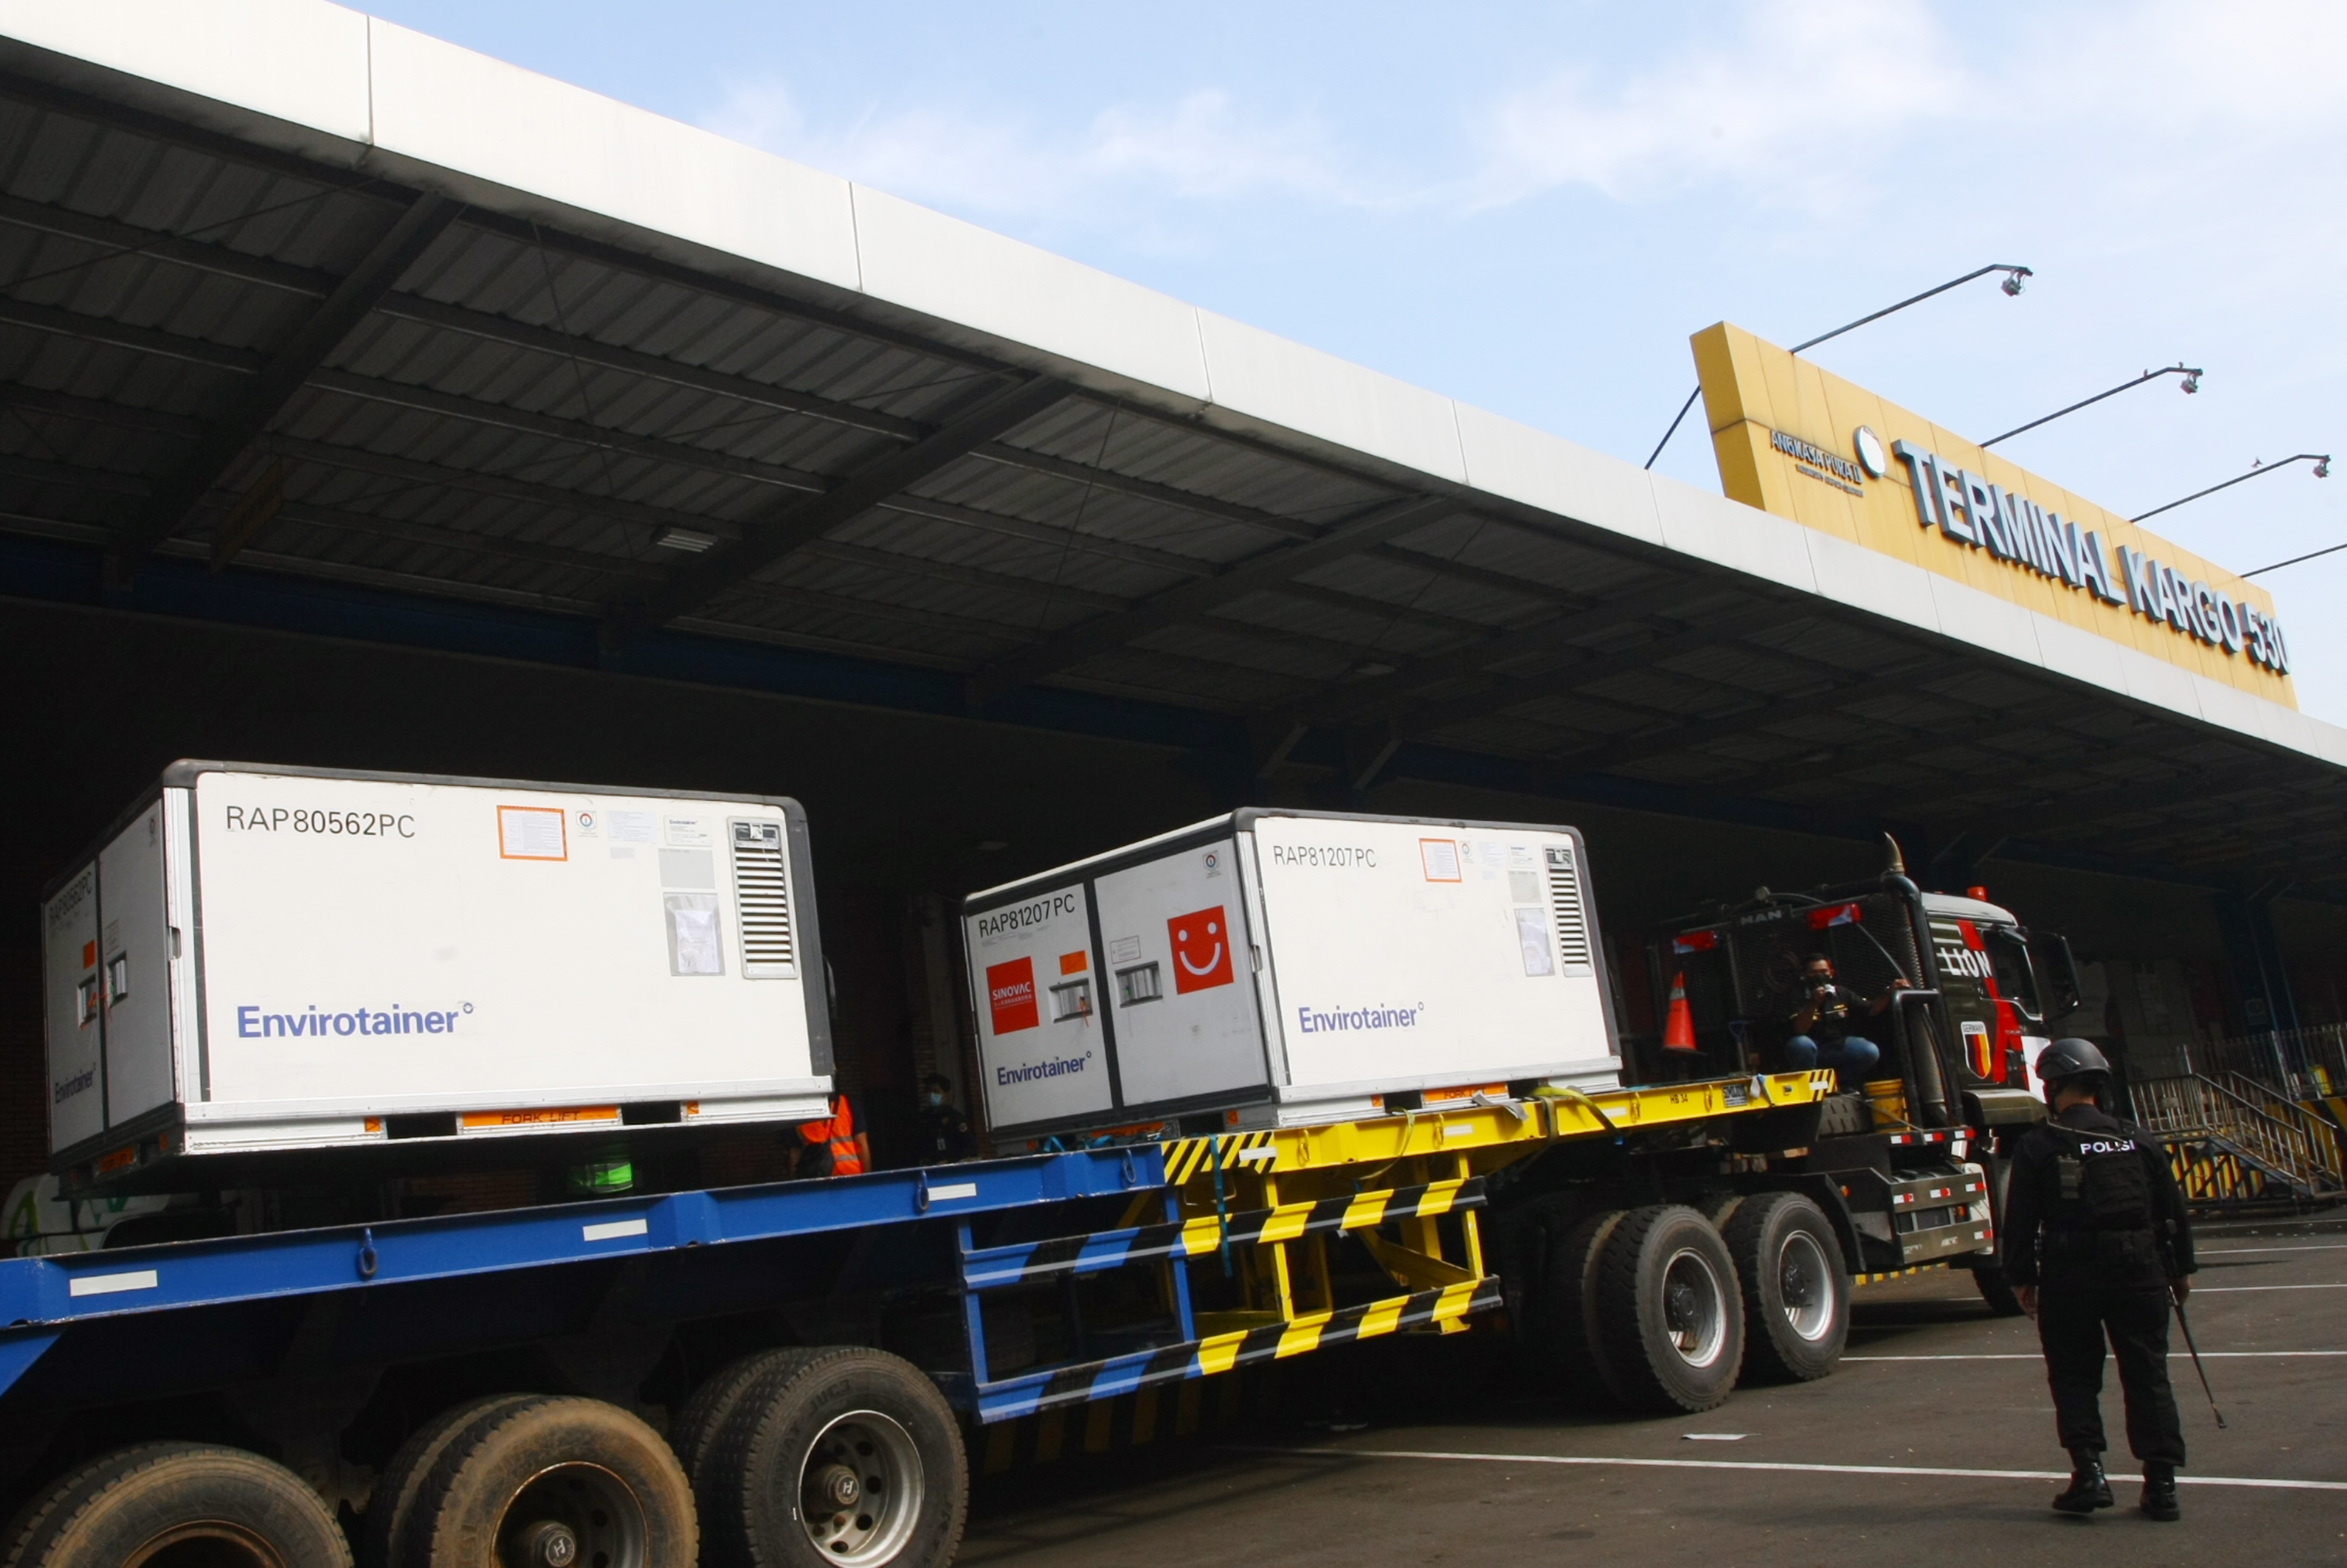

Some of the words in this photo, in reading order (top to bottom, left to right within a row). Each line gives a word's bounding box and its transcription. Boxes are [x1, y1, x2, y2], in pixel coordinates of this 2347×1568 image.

[1770, 429, 1823, 469] ANGKASA
[1822, 453, 1852, 482] PURA
[1892, 439, 2126, 607] TERMINAL
[2115, 544, 2243, 655] KARGO
[2236, 602, 2291, 676] 530
[226, 805, 415, 838] RAP80562PC
[1273, 845, 1377, 868] RAP81207PC
[979, 893, 1075, 938] RAP81207PC
[1740, 910, 1782, 926] MAN
[1940, 947, 1993, 978] LION
[992, 981, 1032, 1001] SINOVAC
[1962, 1024, 1984, 1032] GERMANY
[1445, 1089, 1466, 1100] FORK
[502, 1112, 543, 1125] FORK
[549, 1110, 580, 1122] LIFT
